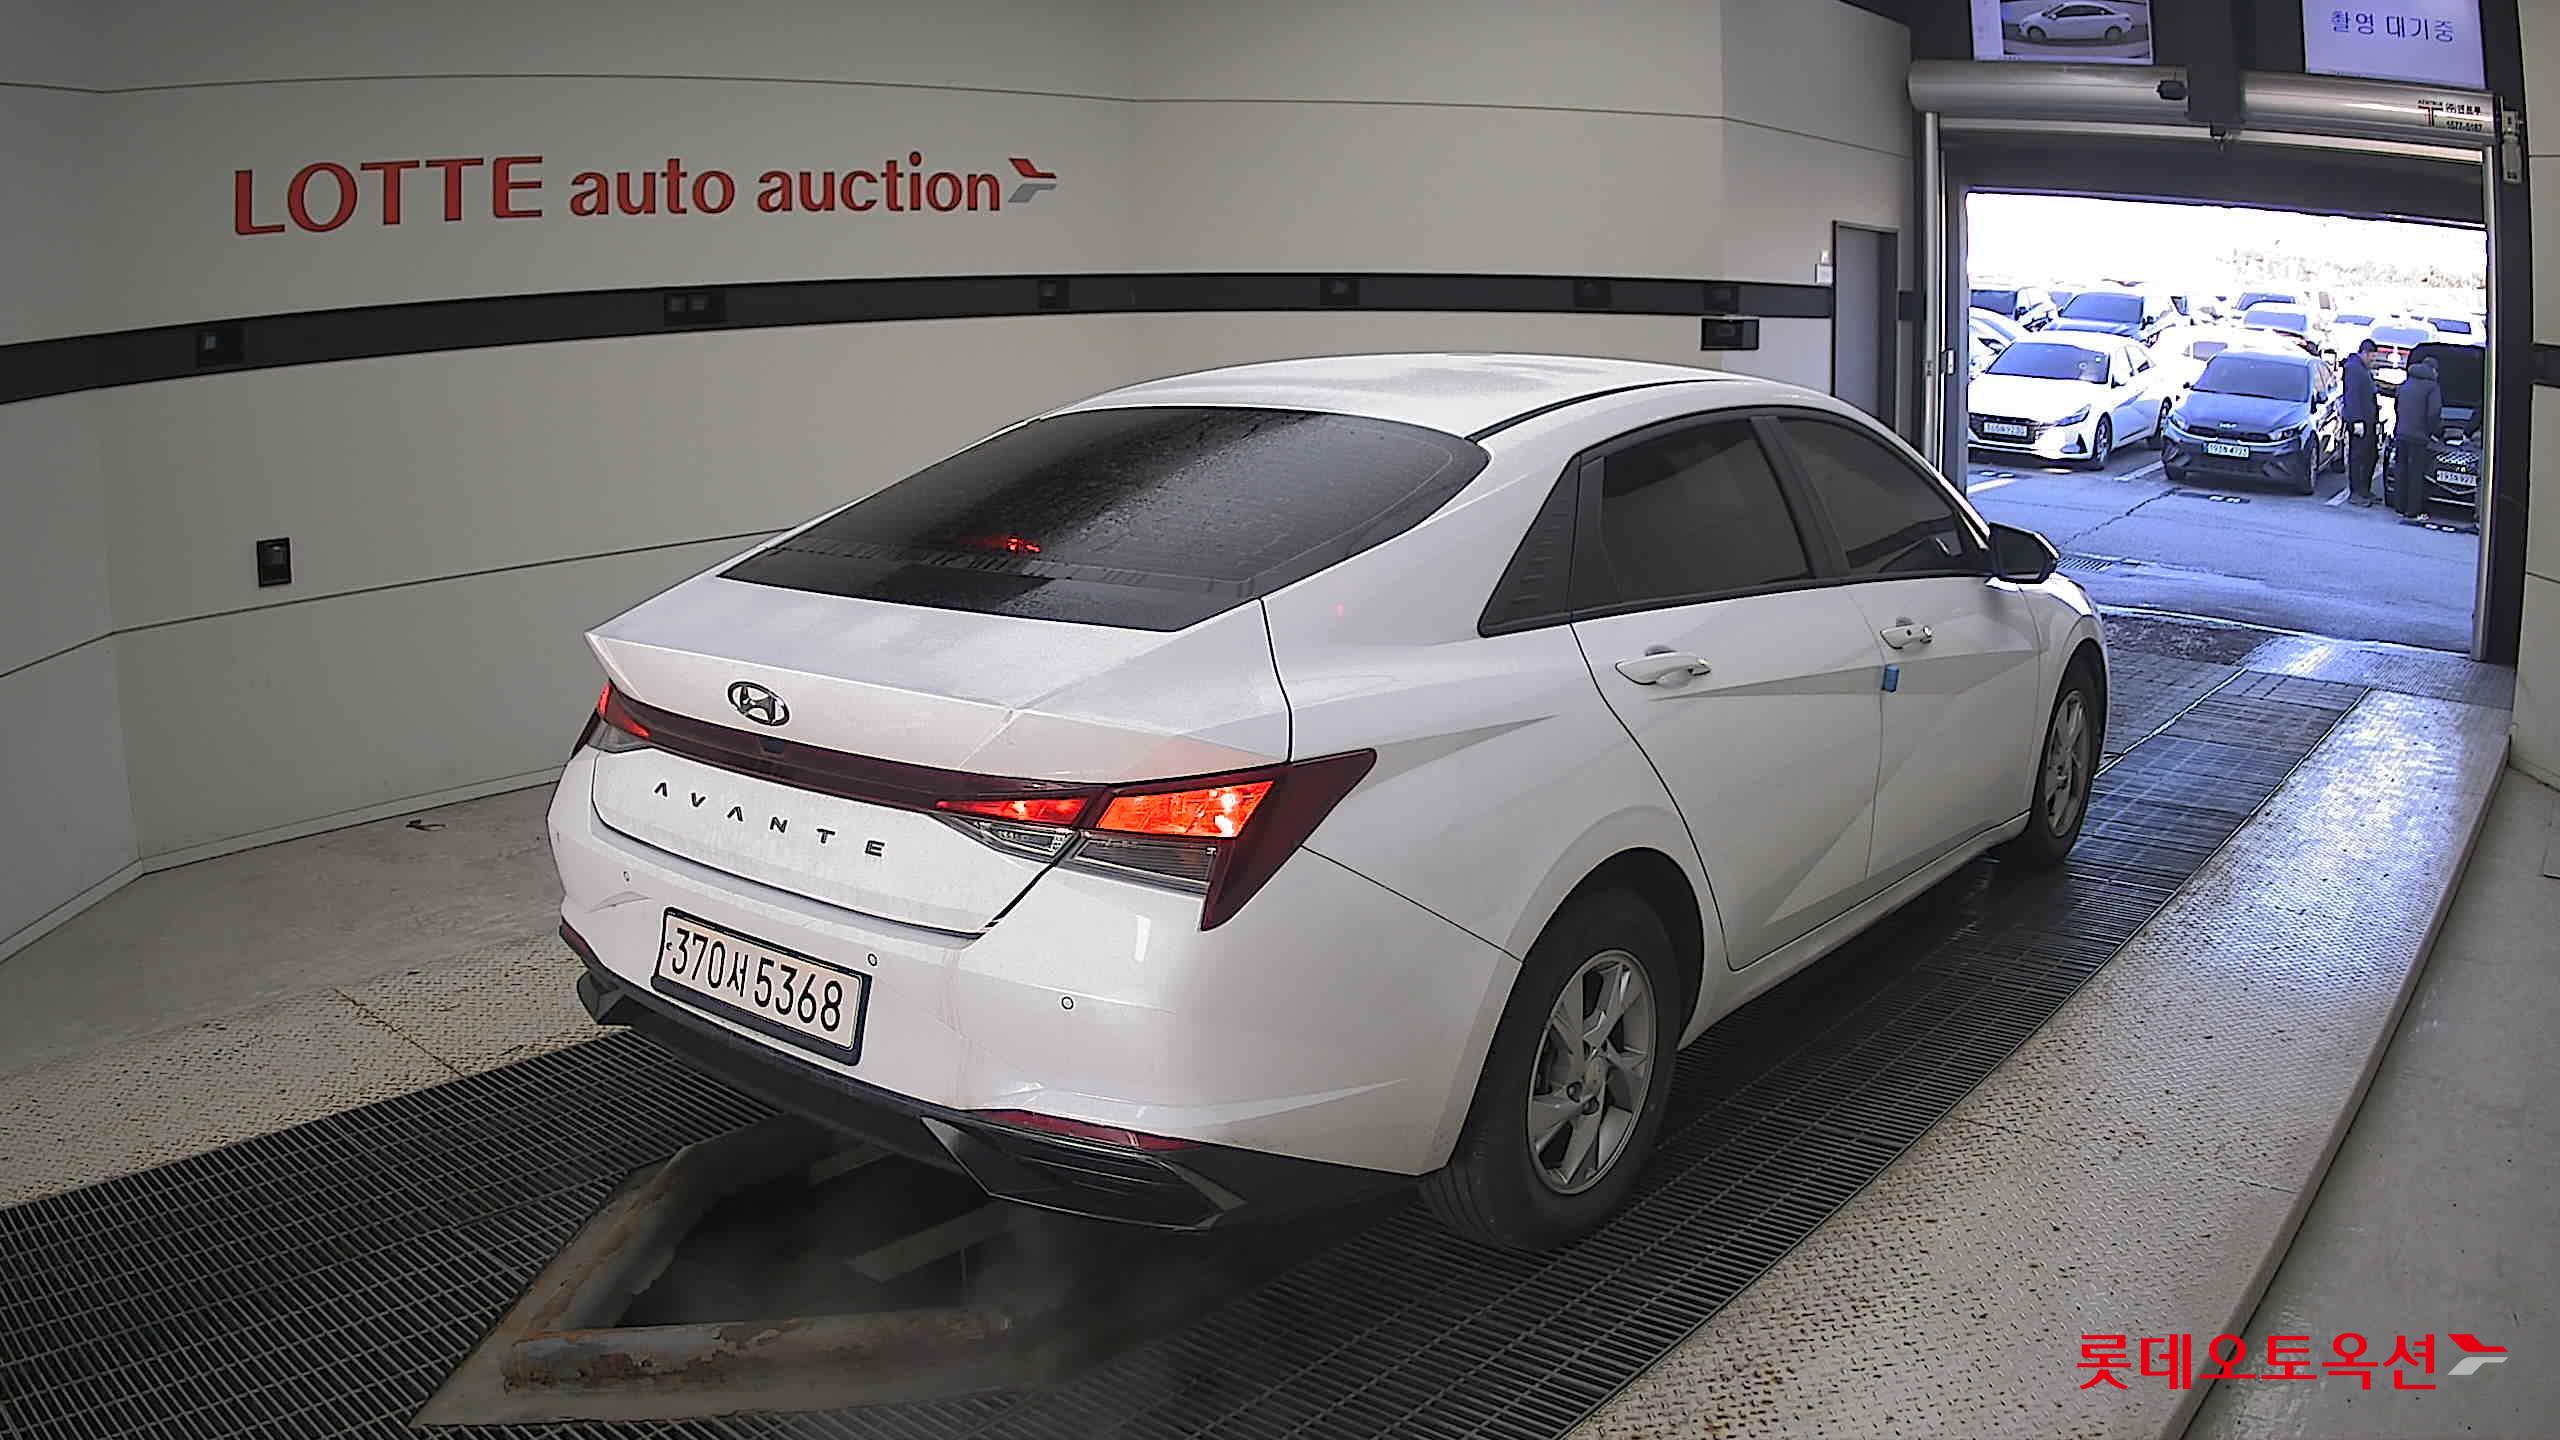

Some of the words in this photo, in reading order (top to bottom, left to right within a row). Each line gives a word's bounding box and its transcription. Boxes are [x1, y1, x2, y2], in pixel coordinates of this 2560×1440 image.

[2332, 11, 2375, 35] 촬영
[233, 155, 544, 236] LOTTE
[569, 158, 737, 216] auto
[756, 151, 1002, 213] auction
[653, 781, 887, 858] AVANTE
